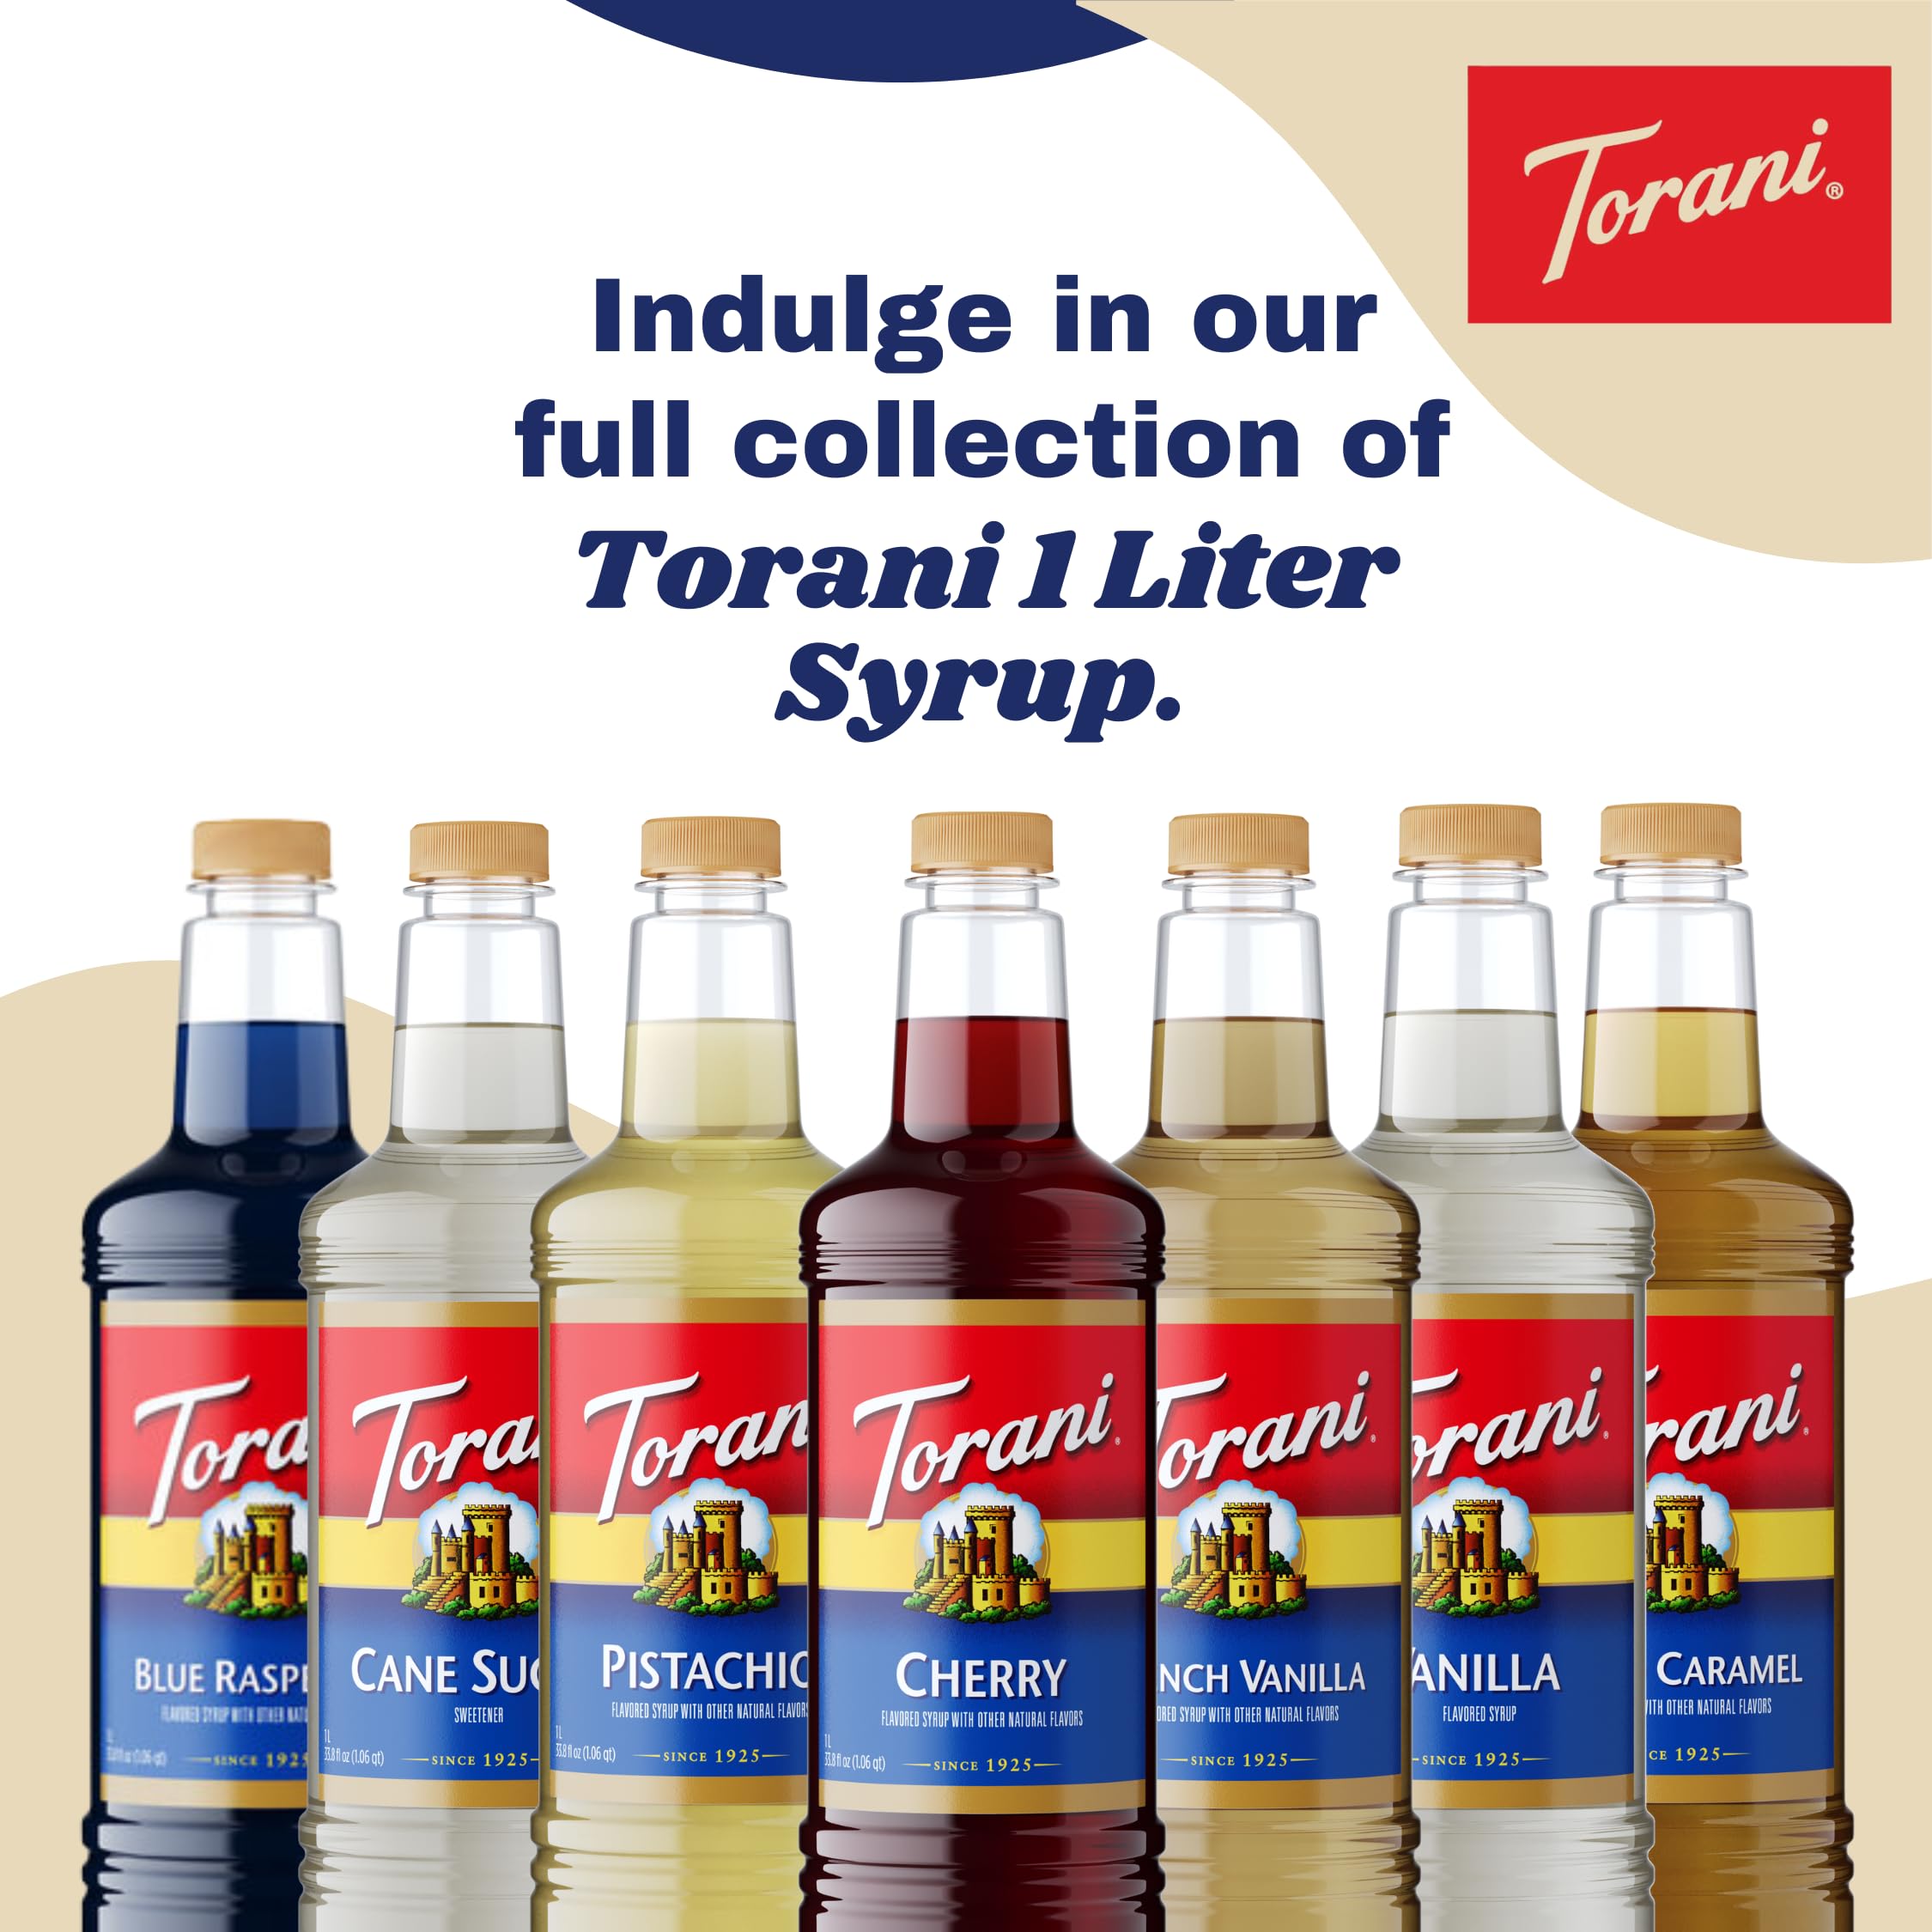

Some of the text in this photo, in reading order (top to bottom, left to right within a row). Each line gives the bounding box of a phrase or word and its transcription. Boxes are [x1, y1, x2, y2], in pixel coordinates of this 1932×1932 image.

[134, 1375, 307, 1527] Tora
[352, 1376, 538, 1528] Tora
[584, 1371, 808, 1524] Toran
[135, 1657, 307, 1694] BLUE RASP
[351, 1647, 458, 1693] CANE
[896, 1651, 1067, 1698] CHERRY
[1159, 1659, 1366, 1693] NCH VANILLA
[1412, 1647, 1560, 1692] ANILLA
[1656, 1651, 1803, 1686] CARAMEL
[454, 1706, 504, 1722] SWEETENER
[611, 1701, 649, 1718] FLAVORED
[652, 1702, 679, 1718] SYRUP
[680, 1703, 703, 1719] WITH
[707, 1703, 733, 1719] OTHER
[737, 1703, 775, 1719] NATURAL
[1157, 1704, 1340, 1723] ORED SYRUP WITH OTHER NATURAL FLAVORS
[1443, 1705, 1517, 1722] FLAVORED SYRUP
[1667, 1698, 1694, 1716] OTHER
[1697, 1698, 1735, 1716] NATURAL
[1739, 1697, 1772, 1714] FLAVORS
[881, 1710, 1084, 1728] FLAVORED SYRUP WITH OTHER NATURAL FLAVORS
[431, 1753, 528, 1766] SINCE 1925
[663, 1749, 760, 1763] SINCE 1925
[1190, 1753, 1288, 1767] SINCE 1925
[1422, 1752, 1520, 1766] SINCE 1925
[1675, 1747, 1721, 1761] 1925
[933, 1758, 1031, 1772] SINCE 1925
